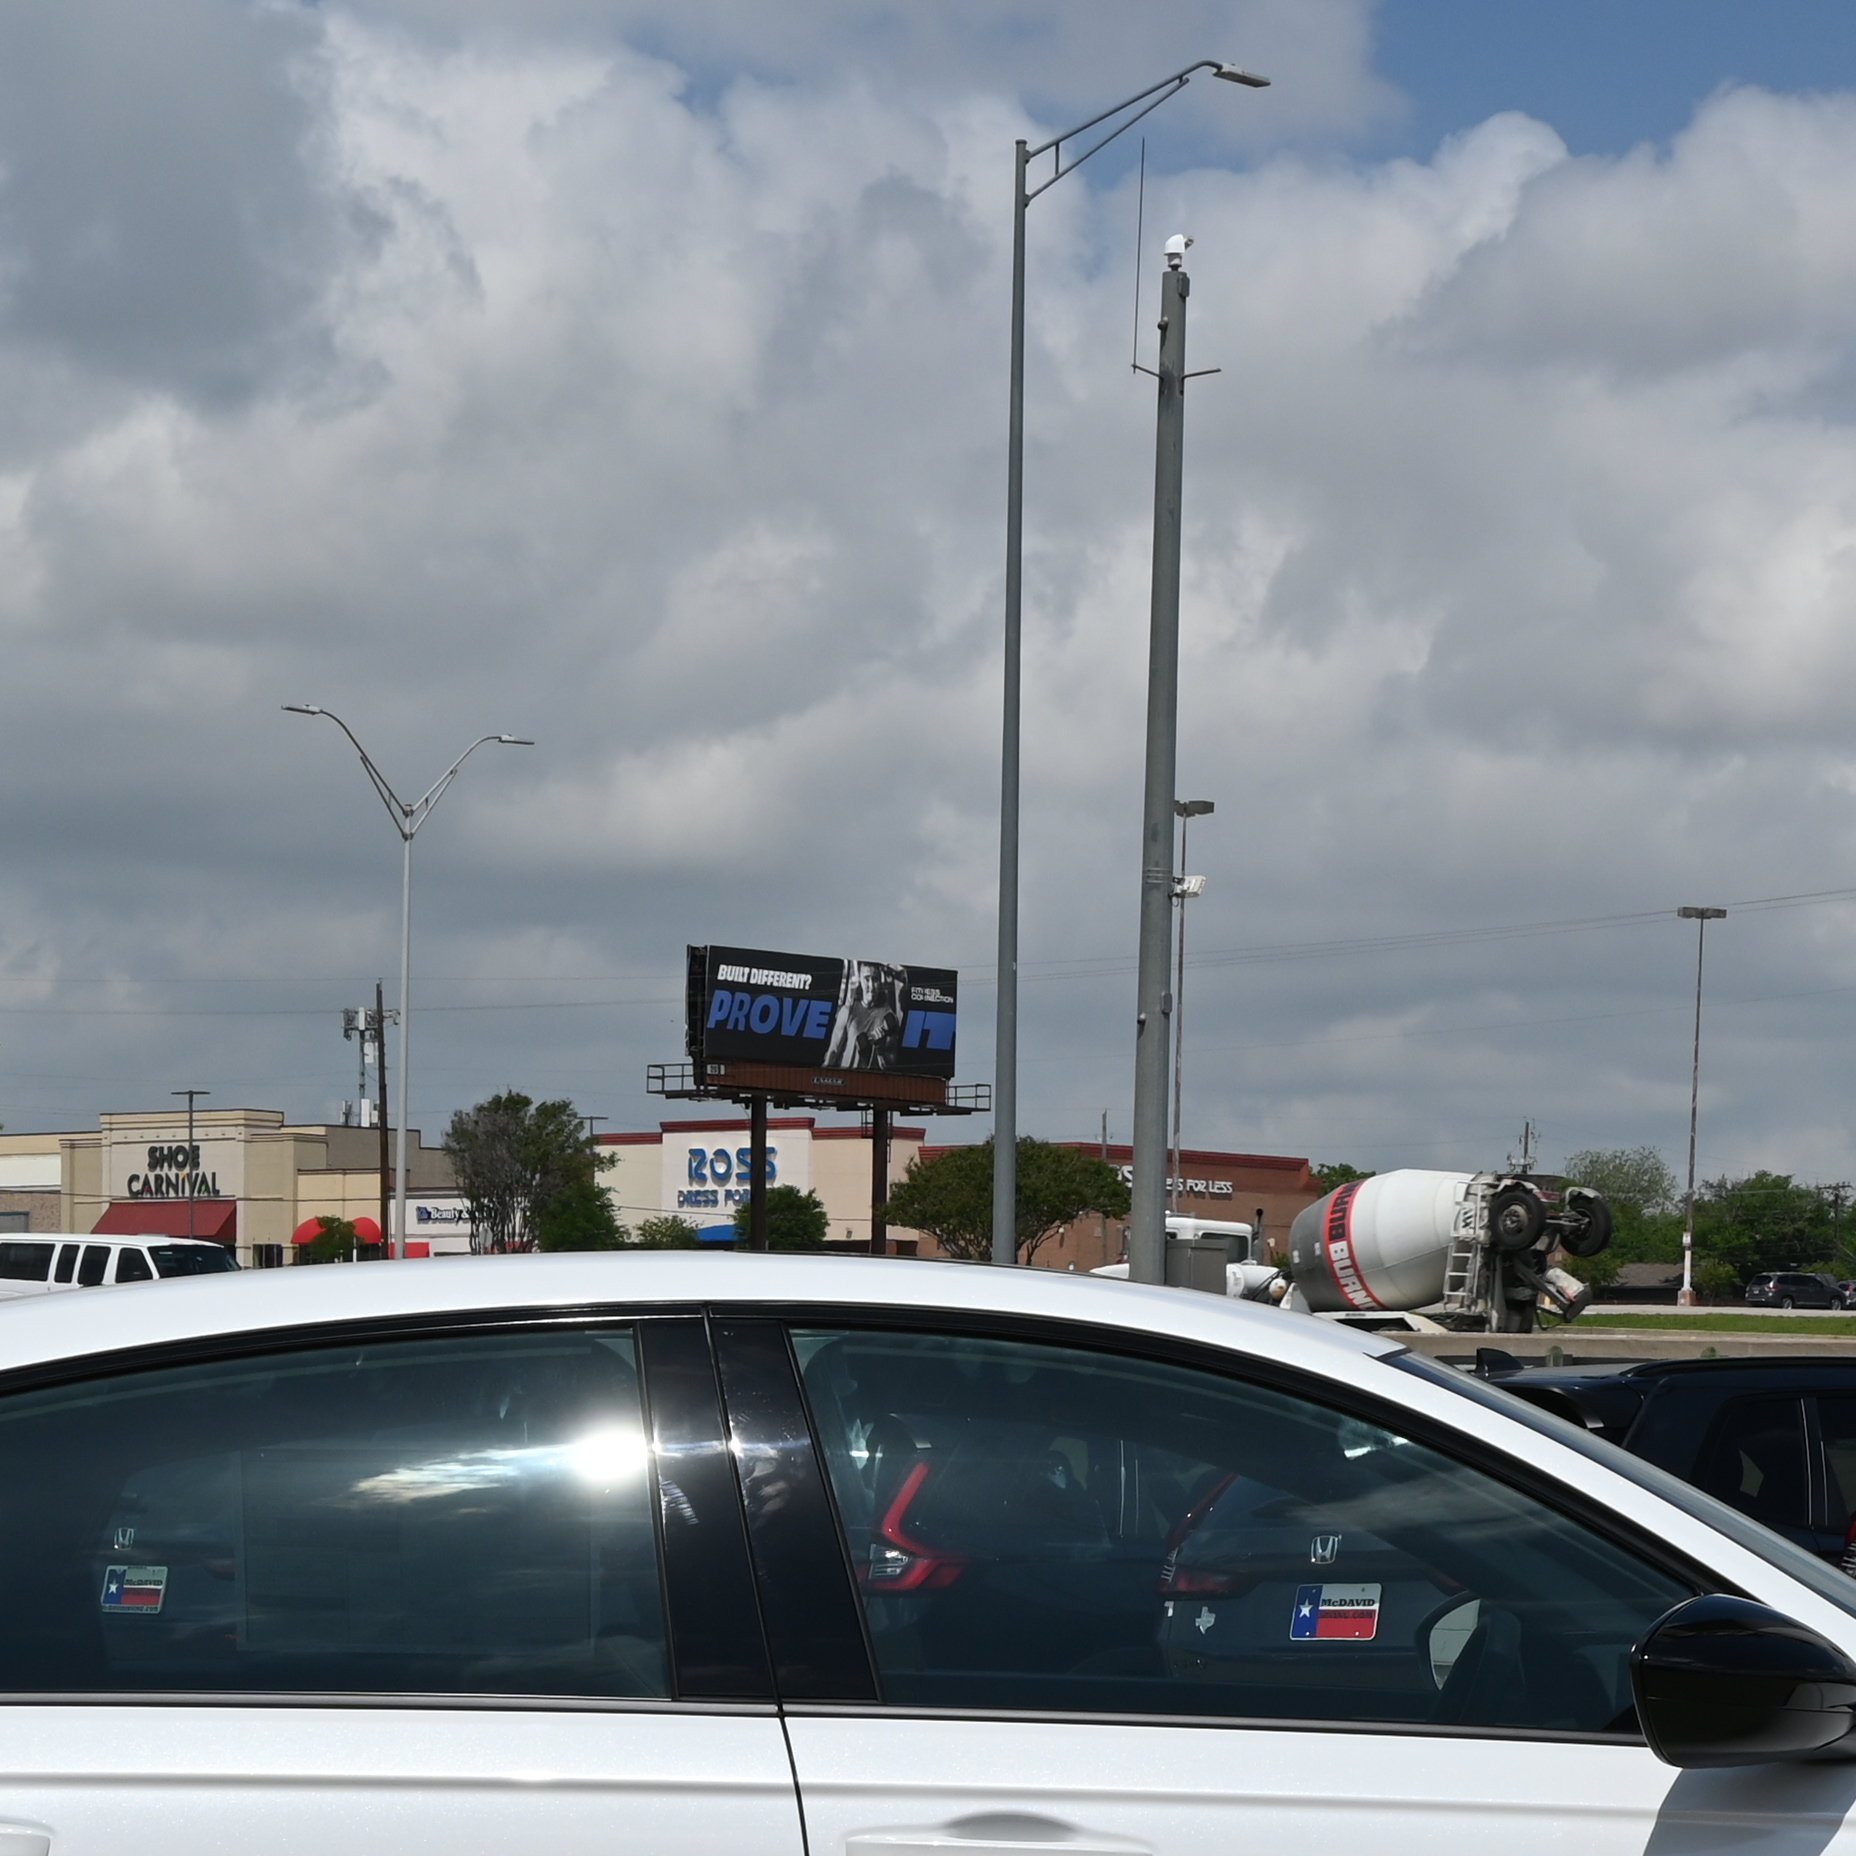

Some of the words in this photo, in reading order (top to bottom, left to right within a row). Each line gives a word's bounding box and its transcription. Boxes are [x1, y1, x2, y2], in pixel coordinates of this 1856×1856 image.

[717, 964, 750, 982] BUILT
[750, 971, 812, 990] DIFFERENT?
[707, 989, 833, 1040] PROVE
[902, 1010, 957, 1050] IT
[147, 1144, 201, 1172] SHOE
[127, 1171, 221, 1198] CARNIVAL
[1186, 1179, 1207, 1192] FOR
[1208, 1180, 1233, 1194] LESS
[677, 1189, 719, 1208] DRESS
[430, 1206, 459, 1220] Beauty
[1321, 1598, 1376, 1607] McDAVID
